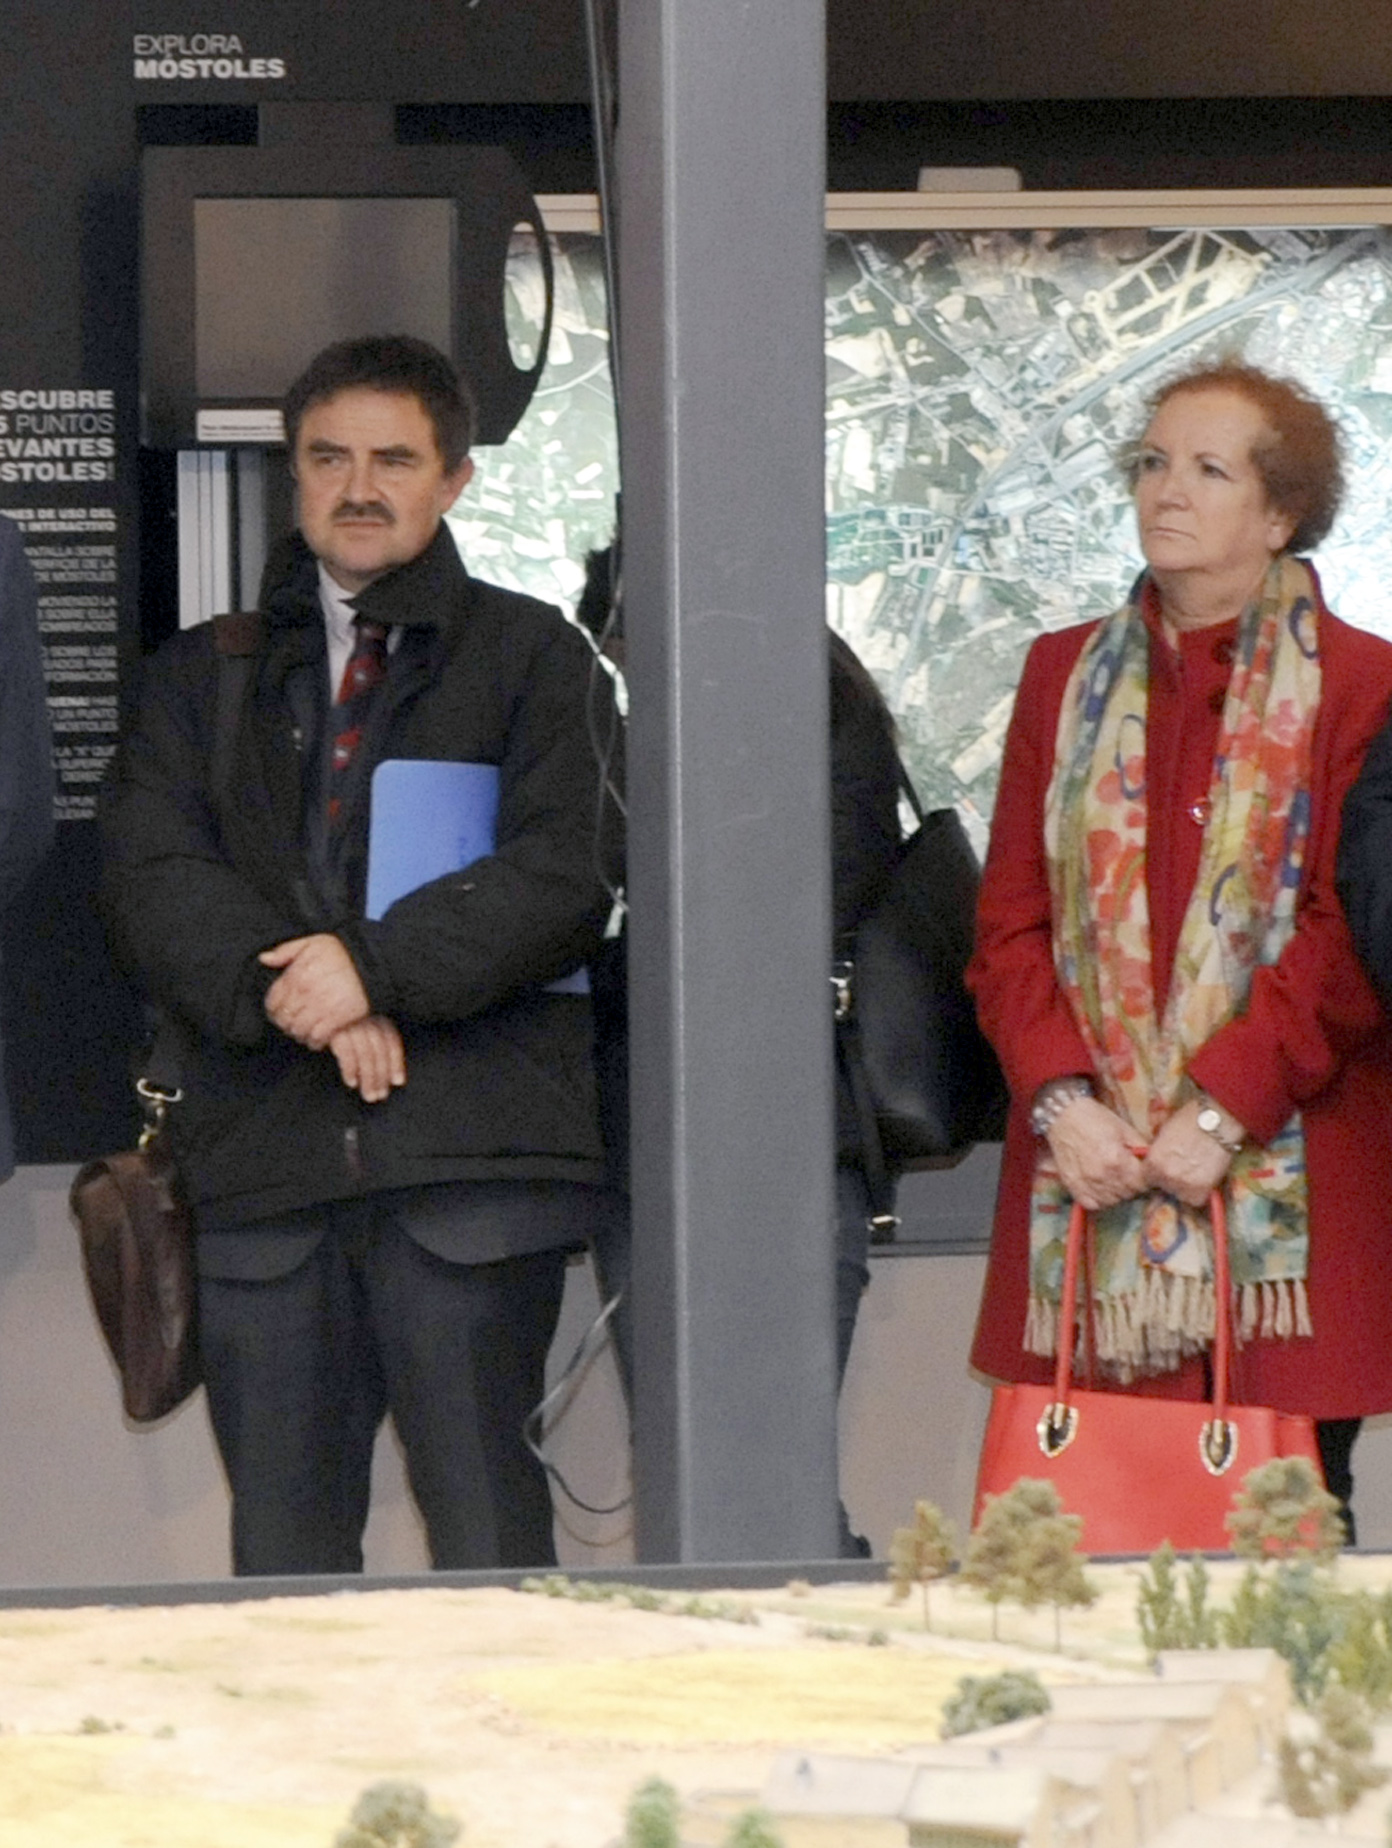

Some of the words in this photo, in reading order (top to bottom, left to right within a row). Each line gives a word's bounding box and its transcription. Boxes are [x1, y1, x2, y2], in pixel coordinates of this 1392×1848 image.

[133, 35, 243, 55] EXPLORA
[134, 54, 286, 79] MÓSTOLES
[15, 412, 115, 435] PUNTOS
[37, 508, 56, 520] DE
[58, 508, 87, 520] USO
[89, 508, 116, 520] DEL
[27, 521, 116, 532] INTERACTIVO
